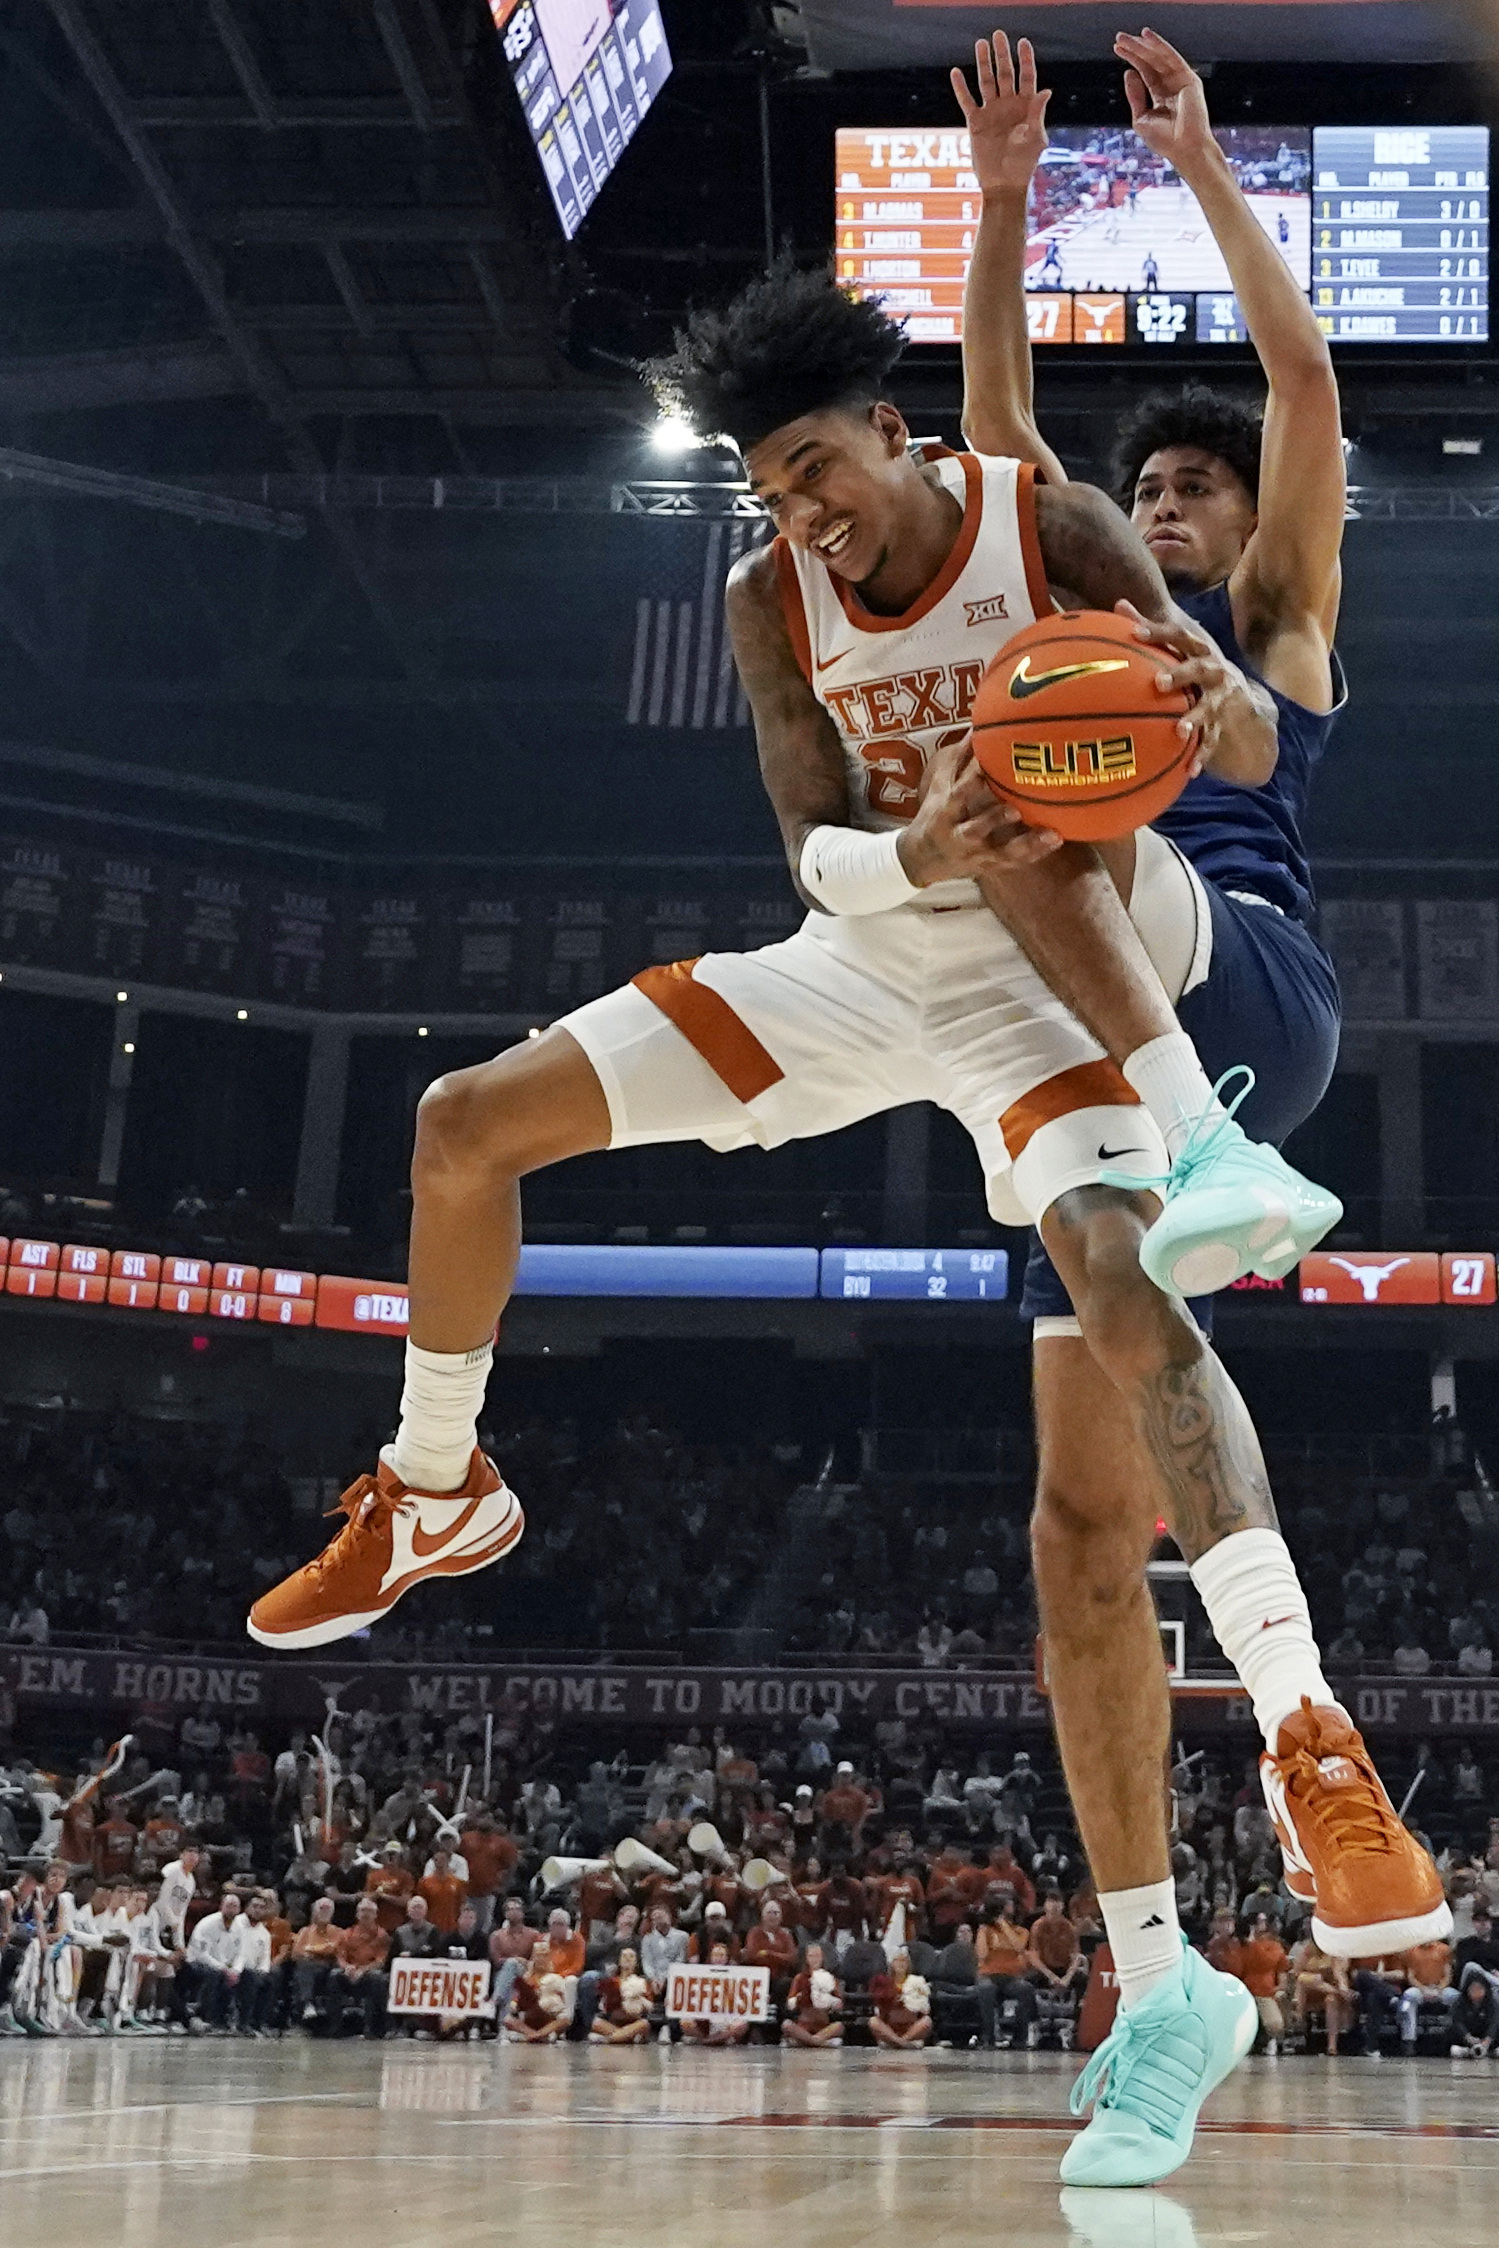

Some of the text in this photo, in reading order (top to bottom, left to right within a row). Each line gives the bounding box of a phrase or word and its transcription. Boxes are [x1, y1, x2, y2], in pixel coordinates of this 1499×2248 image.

[1440, 201, 1451, 218] 3
[1320, 230, 1331, 248] 2
[1440, 259, 1451, 277] 2
[1440, 288, 1451, 306] 2
[823, 659, 984, 741] TEXA
[1012, 733, 1136, 776] ELITE
[21, 1243, 50, 1266] AST
[72, 1249, 98, 1273] FLS
[122, 1255, 147, 1279] STL
[1451, 1258, 1485, 1296] 27
[177, 1289, 190, 1312] 0
[928, 1276, 948, 1299] 32
[354, 1294, 409, 1323] @TEXA
[112, 1662, 261, 1705] HORNS
[408, 1675, 1047, 1718] WELCOME TO MOODY CENTE
[1357, 1688, 1499, 1724] OF THE
[394, 1969, 483, 2010] DEFENSE
[672, 1974, 762, 2016] DEFENSE
